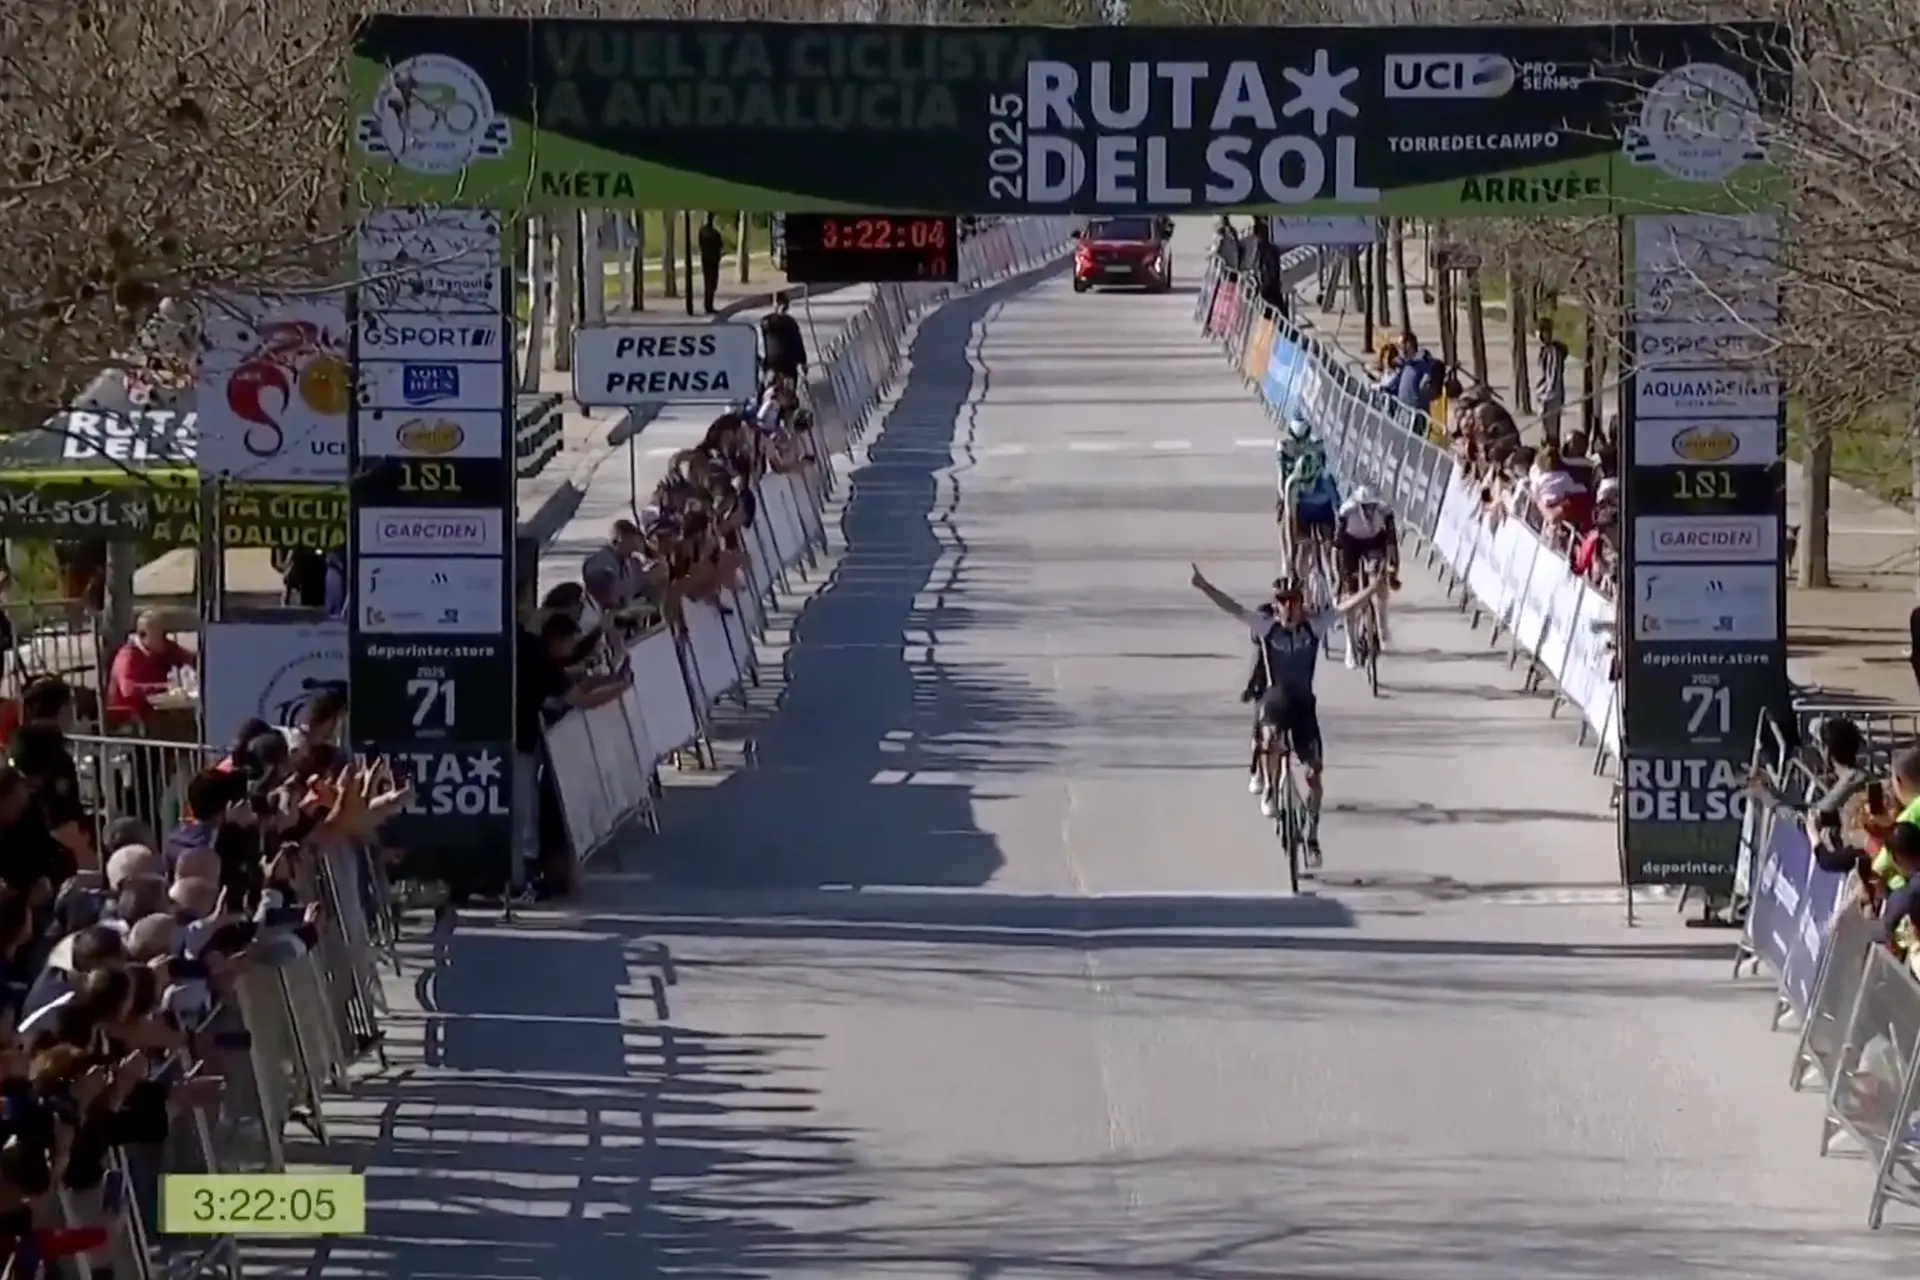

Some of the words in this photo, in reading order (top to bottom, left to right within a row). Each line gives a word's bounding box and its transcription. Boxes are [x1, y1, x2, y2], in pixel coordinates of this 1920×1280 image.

[544, 31, 774, 78] VUELTA
[793, 31, 1048, 80] CICLISTA
[1523, 61, 1557, 76] PRO
[1394, 62, 1464, 90] UCI
[542, 80, 588, 128] A
[1027, 60, 1277, 130] RUTA
[988, 92, 1024, 200] 2025
[1388, 132, 1559, 152] TORREDELCAMPO
[541, 171, 635, 199] META
[823, 219, 945, 249] 3:22:04
[364, 327, 470, 346] GSPORT
[616, 334, 717, 358] PRESS
[606, 370, 731, 394] PRENSA
[311, 441, 346, 455] UCI
[384, 524, 478, 539] GARCIDEN
[1660, 531, 1751, 546] GARCIDEN
[367, 644, 495, 660] deporinter.store
[1643, 651, 1770, 666] deporinter.store
[407, 679, 455, 727] 71
[1682, 686, 1731, 734] 71
[1628, 759, 1737, 790] RUTA
